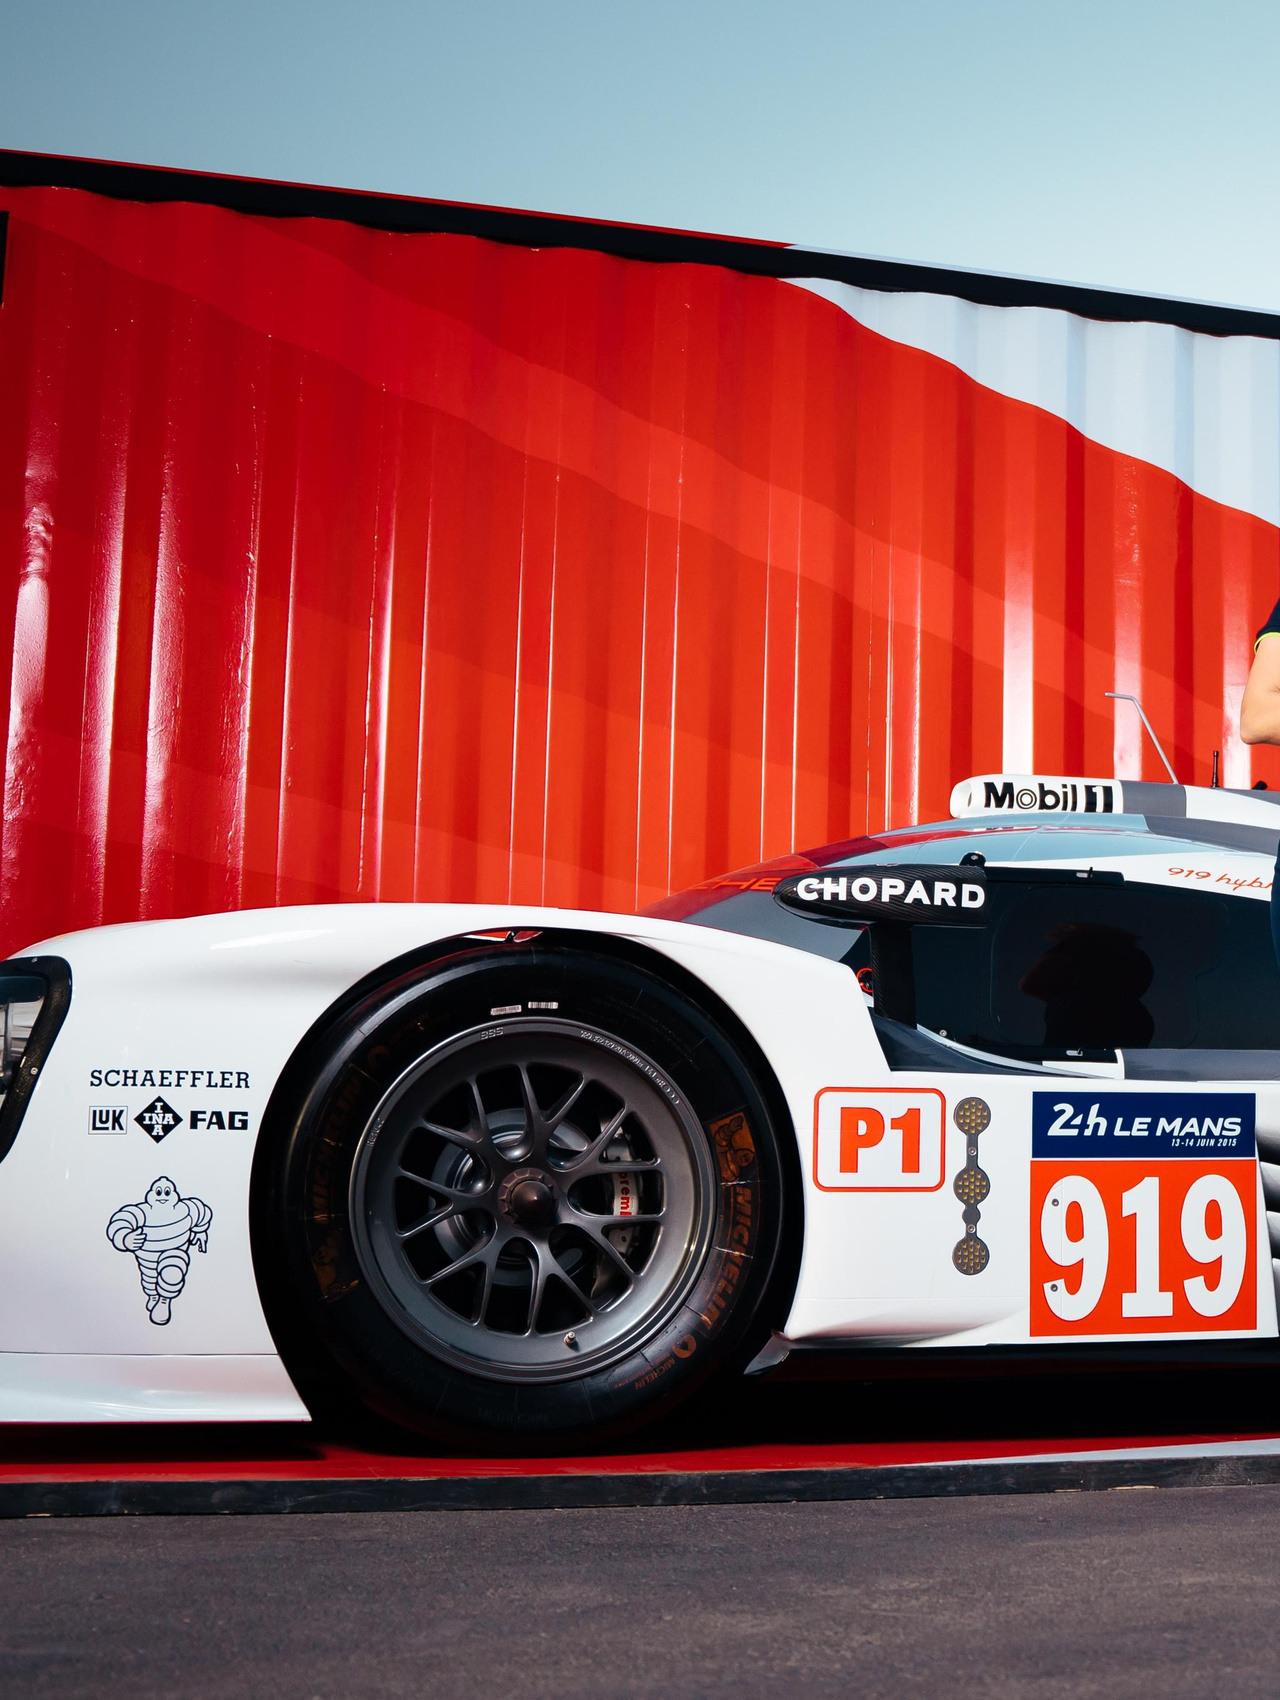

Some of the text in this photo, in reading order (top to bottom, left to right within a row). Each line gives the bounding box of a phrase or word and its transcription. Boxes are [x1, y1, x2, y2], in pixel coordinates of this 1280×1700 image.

[984, 782, 1077, 812] Mobil
[1168, 867, 1212, 880] 919
[797, 877, 986, 909] CHOPARD
[90, 1069, 250, 1089] SCHAEFFLER
[190, 1110, 249, 1131] FAG
[1047, 1102, 1242, 1136] 24h LE MANS
[839, 1106, 921, 1174] P1
[1171, 1138, 1238, 1148] 13-14 JUIN 2015
[700, 1186, 753, 1331] MICHELIN
[1040, 1174, 1248, 1322] 919
[634, 1357, 677, 1391] MICHELIN
